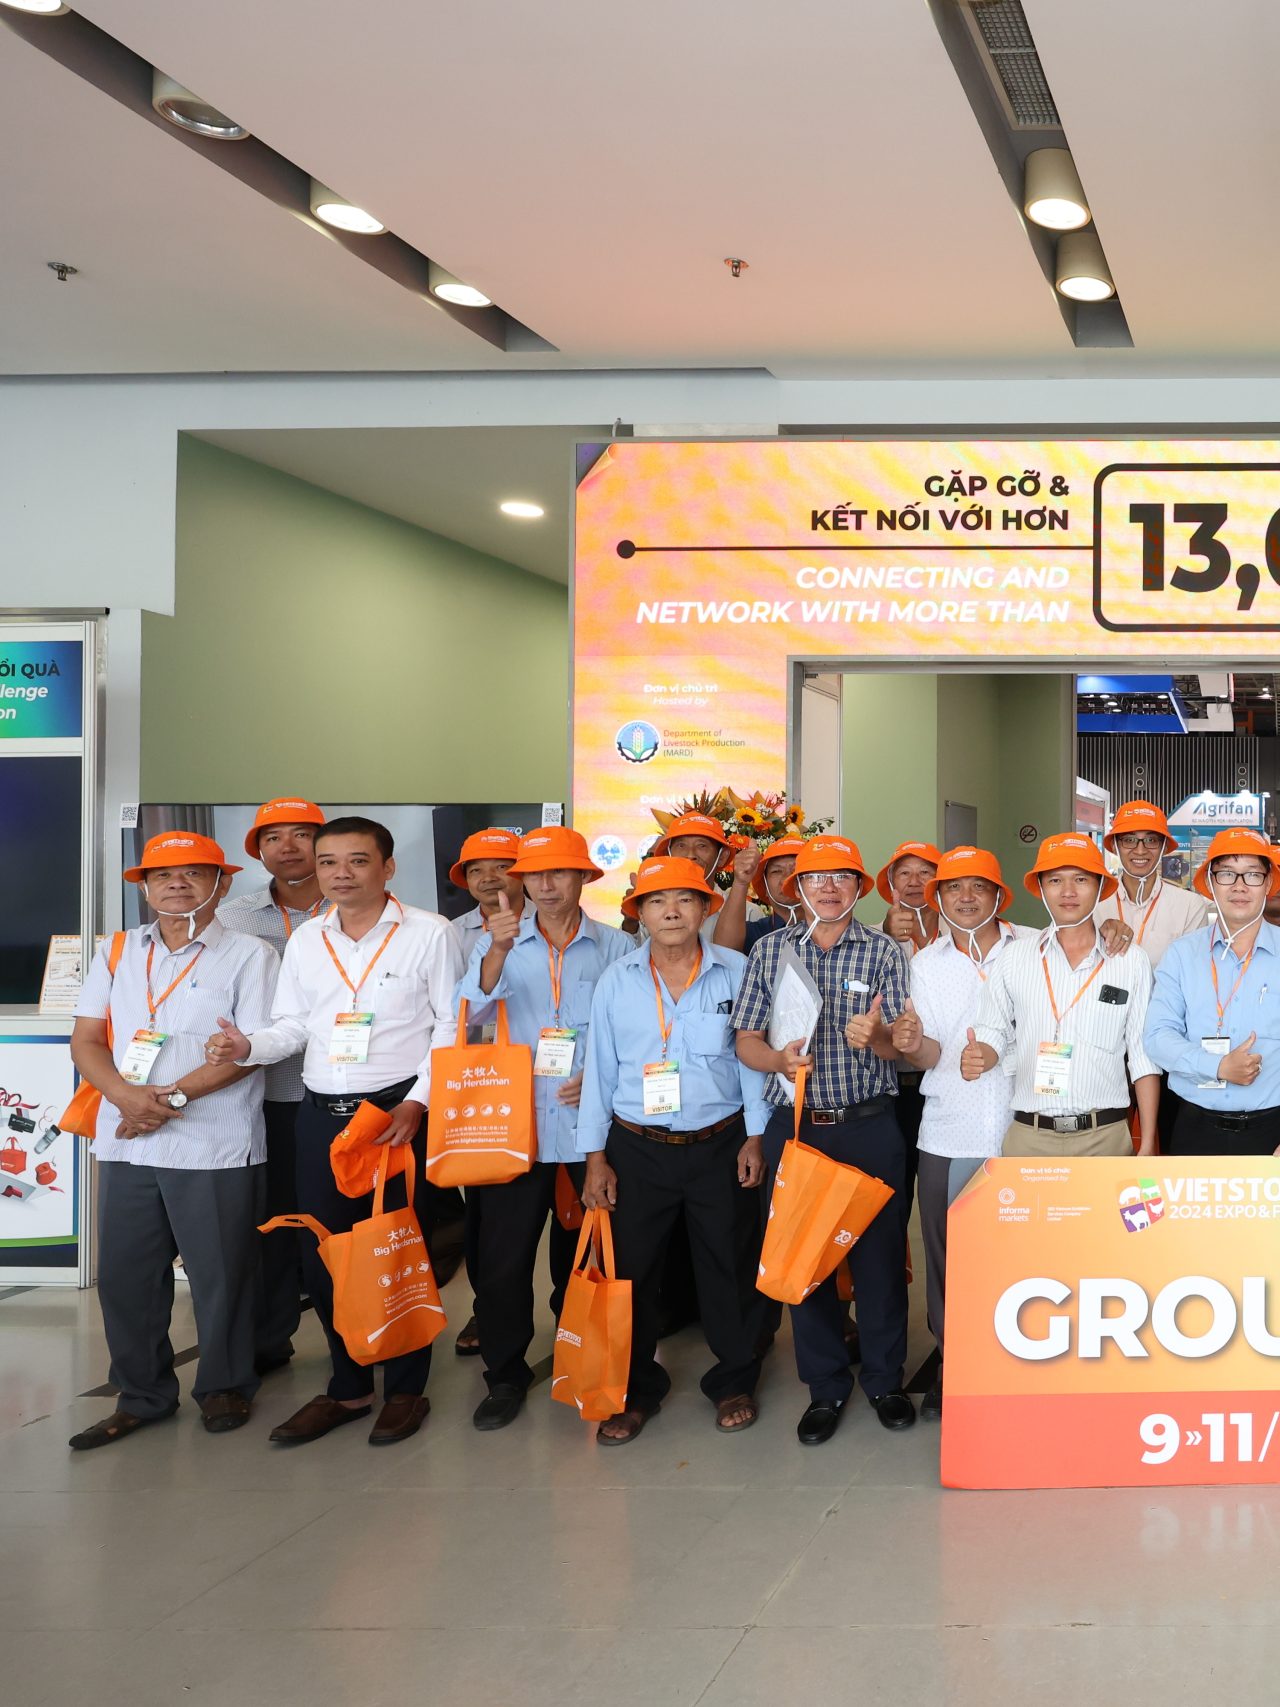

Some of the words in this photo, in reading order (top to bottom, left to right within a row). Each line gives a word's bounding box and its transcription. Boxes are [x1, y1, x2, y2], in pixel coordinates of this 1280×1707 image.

[924, 469, 987, 502] GẶP
[996, 469, 1041, 497] GỠ
[1050, 475, 1070, 497] &
[811, 501, 867, 531] KẾT
[876, 501, 930, 531] NỐI
[938, 501, 992, 531] VỚI
[1002, 507, 1070, 531] HƠN
[796, 566, 996, 590] CONNECTING
[1000, 566, 1071, 589] AND
[636, 600, 795, 624] NETWORK
[800, 600, 880, 623] WITH
[887, 600, 979, 623] MORE
[983, 600, 1070, 622] THAN
[0, 658, 16, 677] ỔI
[21, 659, 60, 680] QUÀ
[0, 683, 49, 702] lenge
[663, 729, 712, 739] Department
[713, 729, 722, 738] of
[663, 739, 700, 747] Livestock
[701, 739, 746, 747] Production
[663, 748, 694, 758] (MARD)
[1193, 801, 1253, 817] Agrifan
[462, 1065, 498, 1079] 大牧人
[446, 1080, 462, 1091] Big
[463, 1078, 510, 1089] Herdsman
[652, 1105, 673, 1113] VISITOR
[999, 1206, 1030, 1214] informa
[1168, 1204, 1212, 1219] 2024
[999, 1214, 1029, 1222] markets
[374, 1247, 390, 1257] Big
